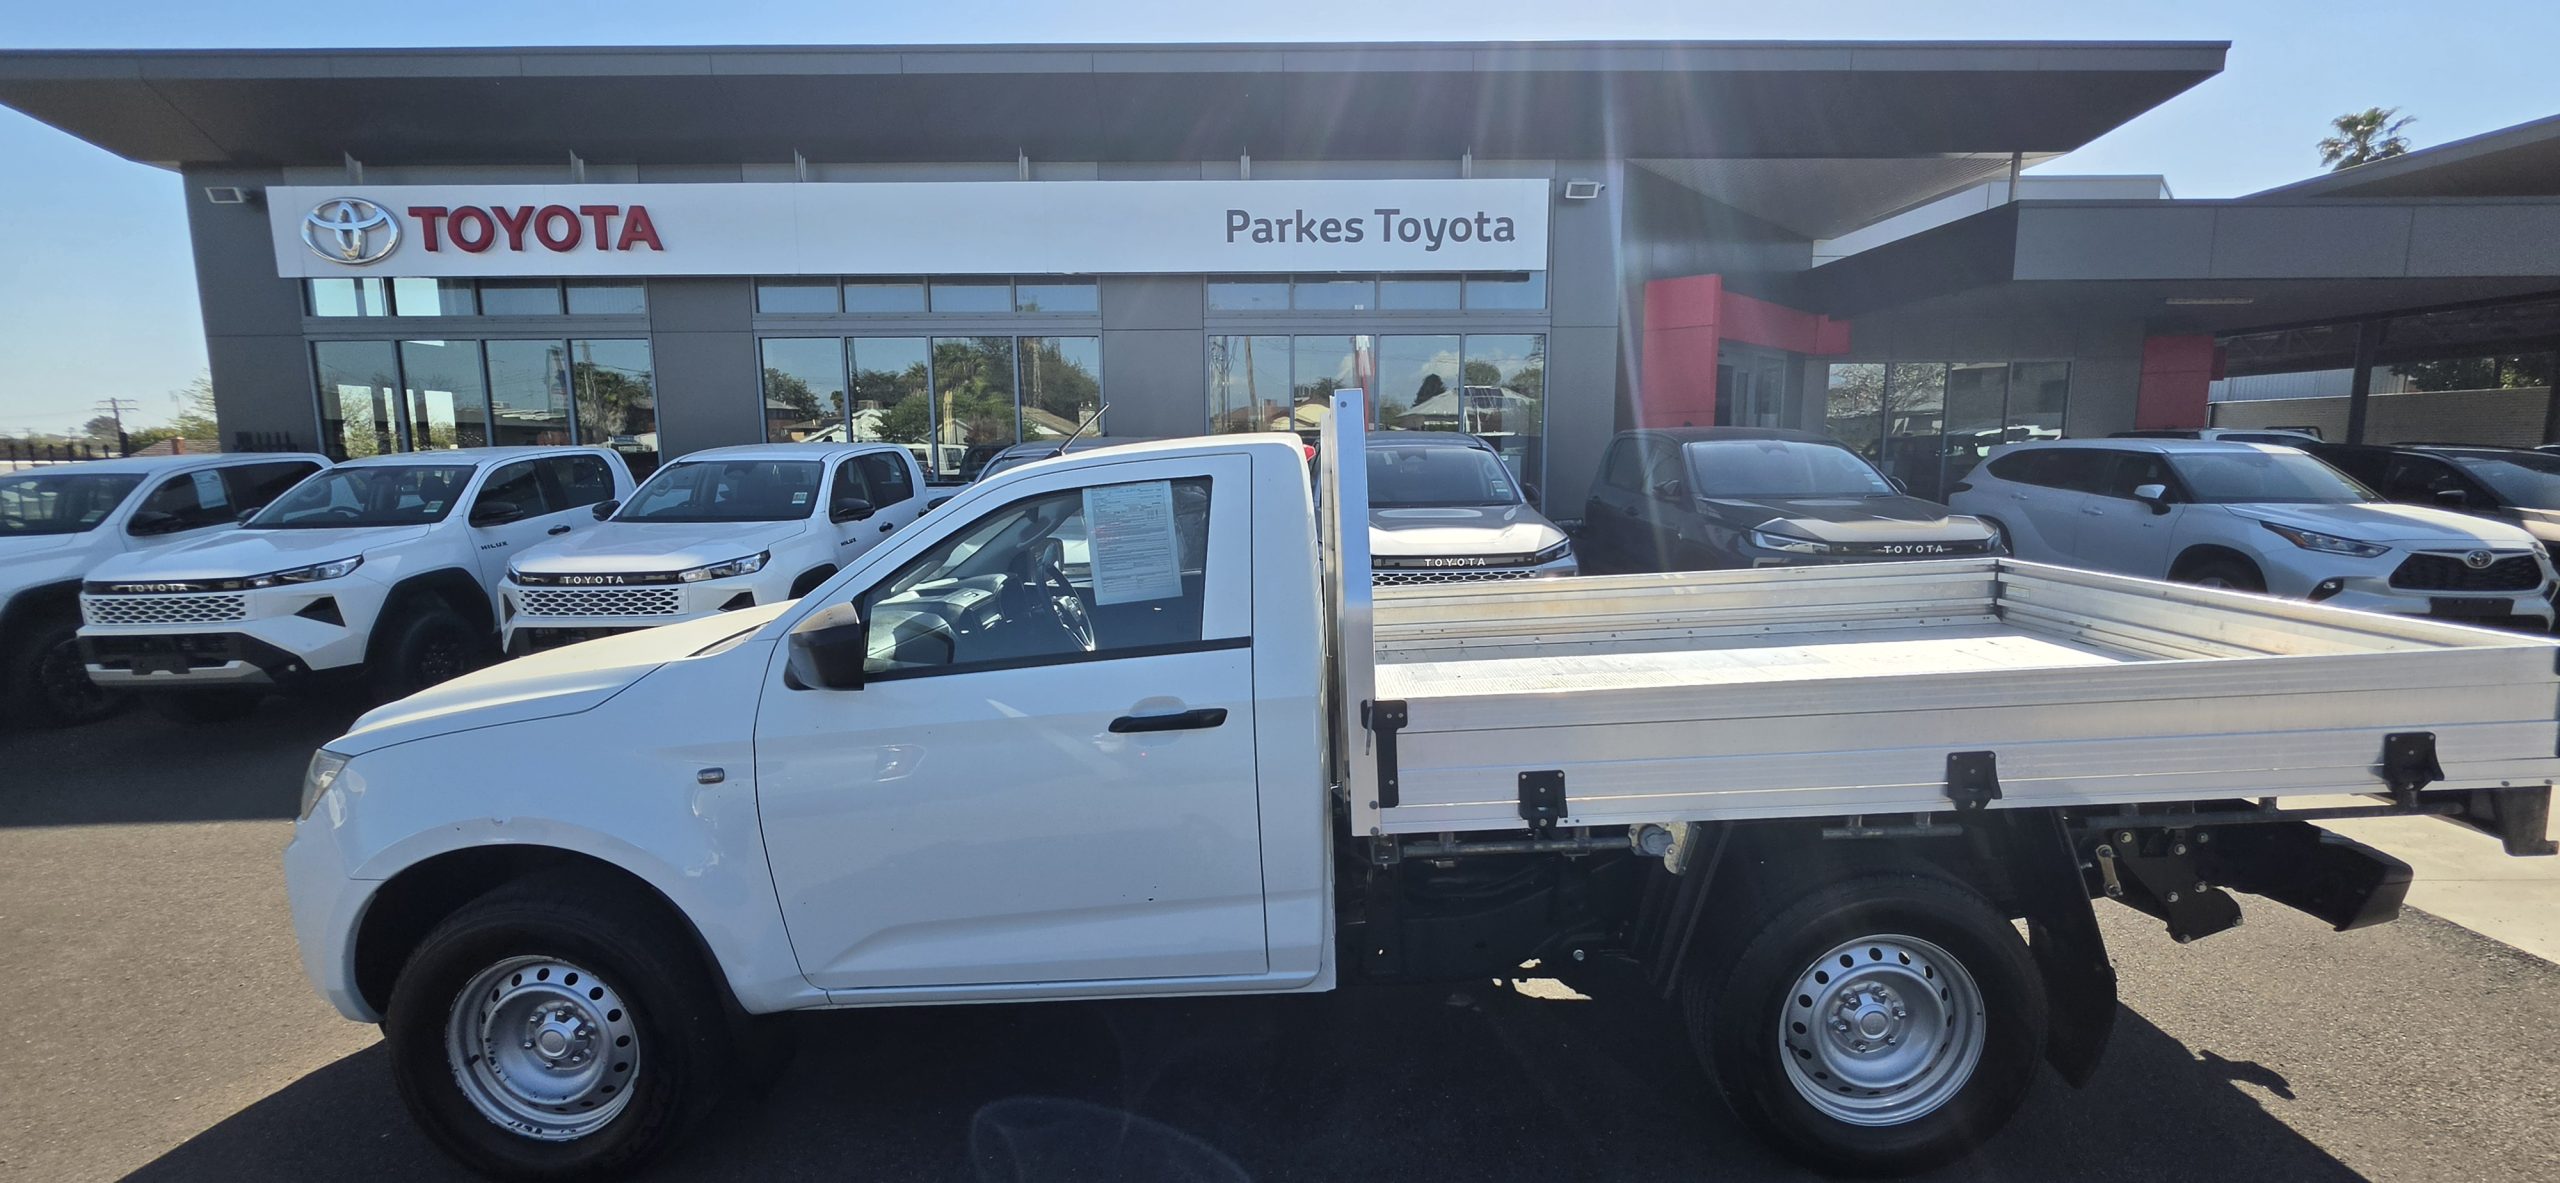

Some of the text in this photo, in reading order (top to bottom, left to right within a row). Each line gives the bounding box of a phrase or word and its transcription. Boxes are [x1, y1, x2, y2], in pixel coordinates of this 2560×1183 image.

[408, 204, 665, 253] TOYOTA
[1226, 208, 1515, 252] Parkes Toyota
[481, 541, 508, 551] HILUX
[1884, 544, 1944, 554] TOYOTA
[1425, 557, 1486, 567] TOYOTA
[564, 575, 625, 585] TOYOTA
[128, 583, 188, 593] TOYOTA
